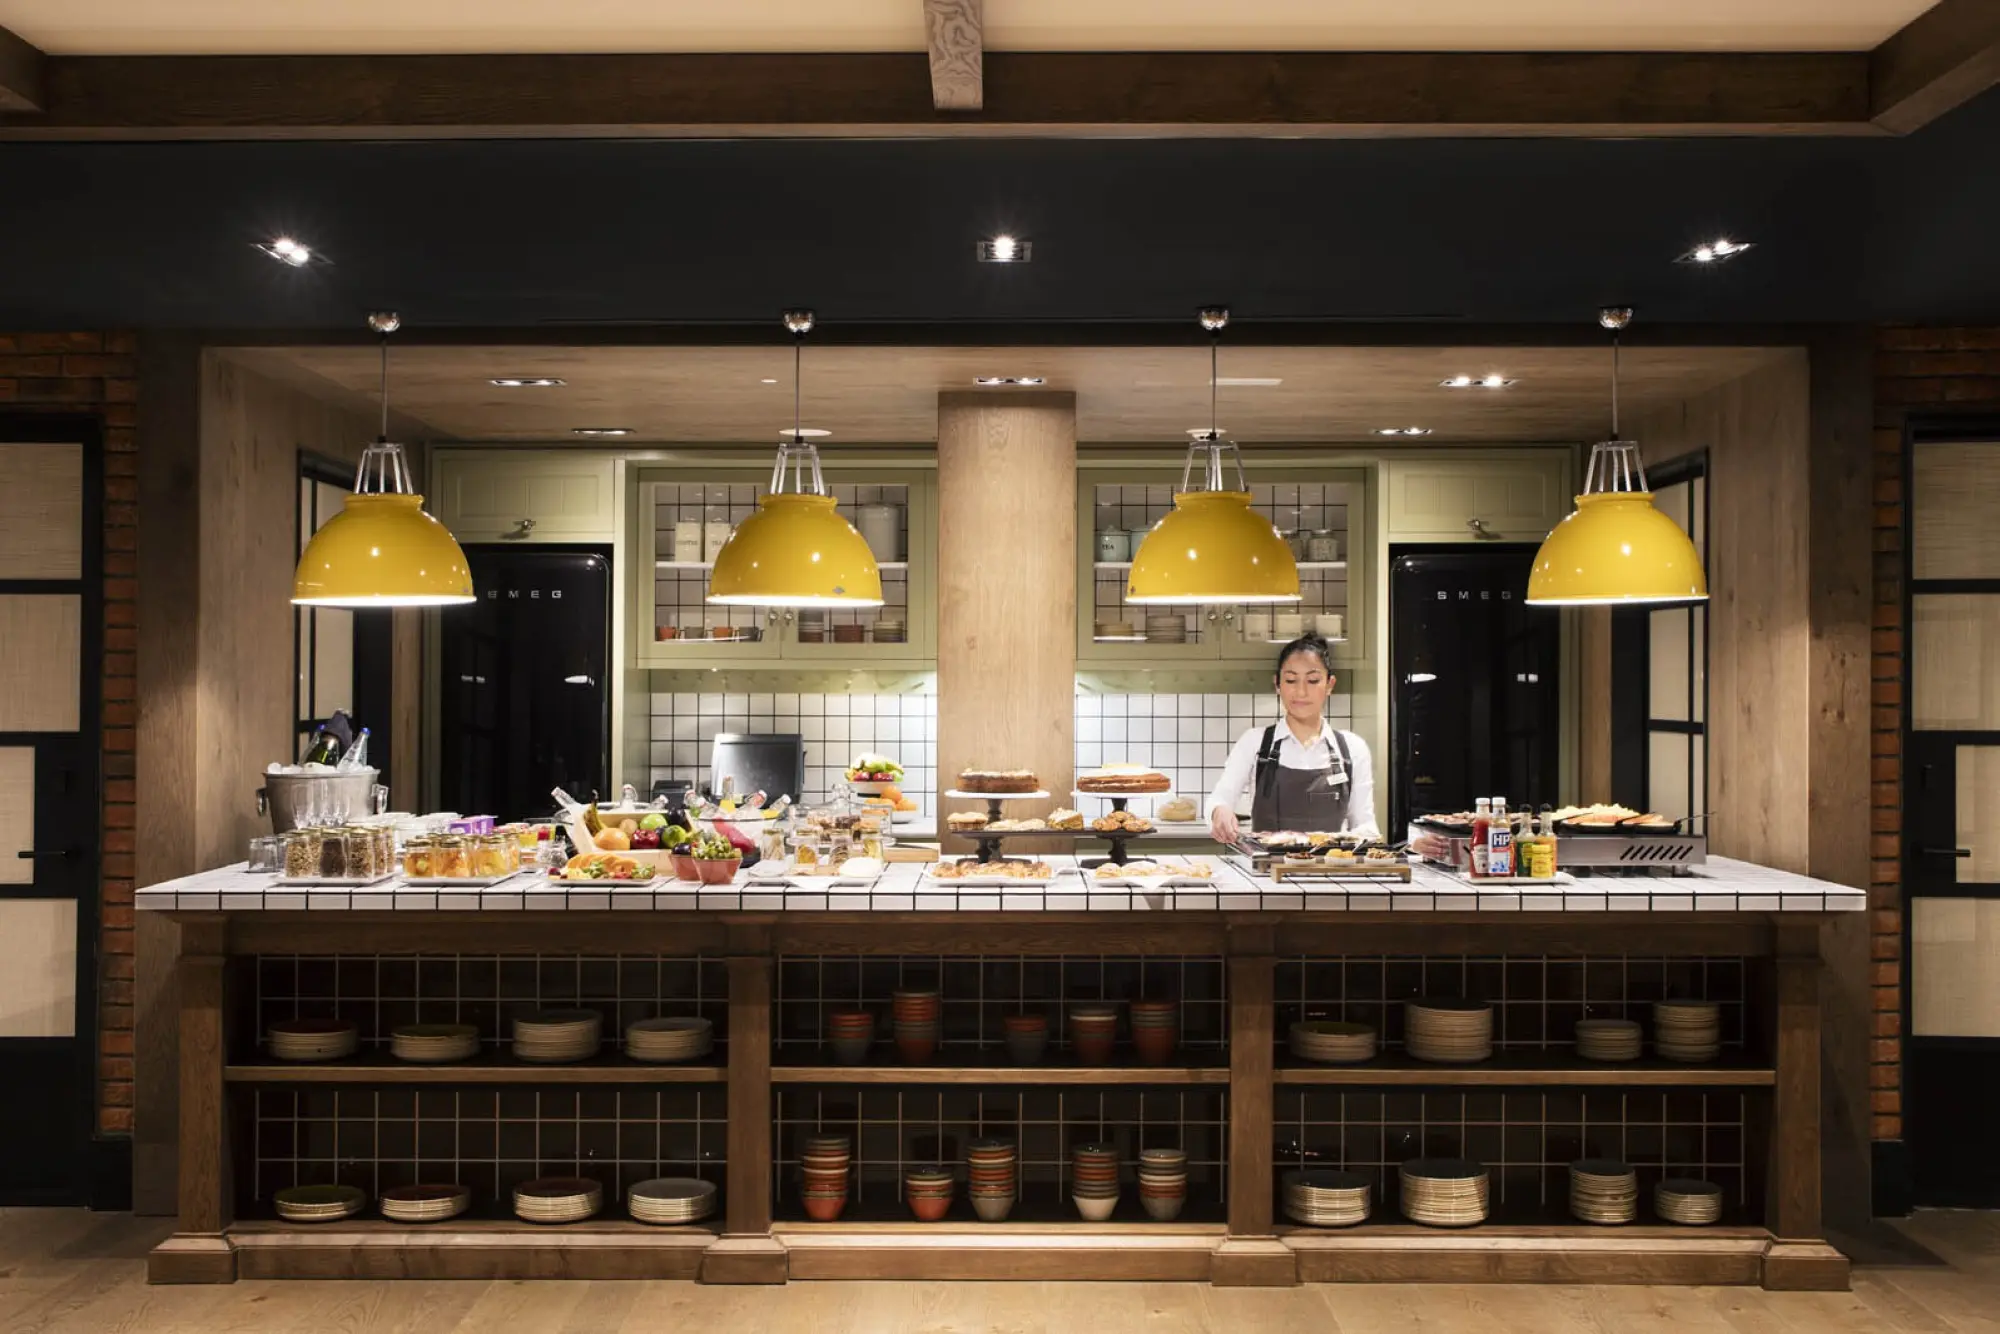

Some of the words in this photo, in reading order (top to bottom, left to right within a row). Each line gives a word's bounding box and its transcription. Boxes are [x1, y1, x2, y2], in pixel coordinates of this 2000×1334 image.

[487, 590, 561, 599] SMEG
[1437, 590, 1511, 600] SMEG
[1493, 833, 1510, 846] HP
